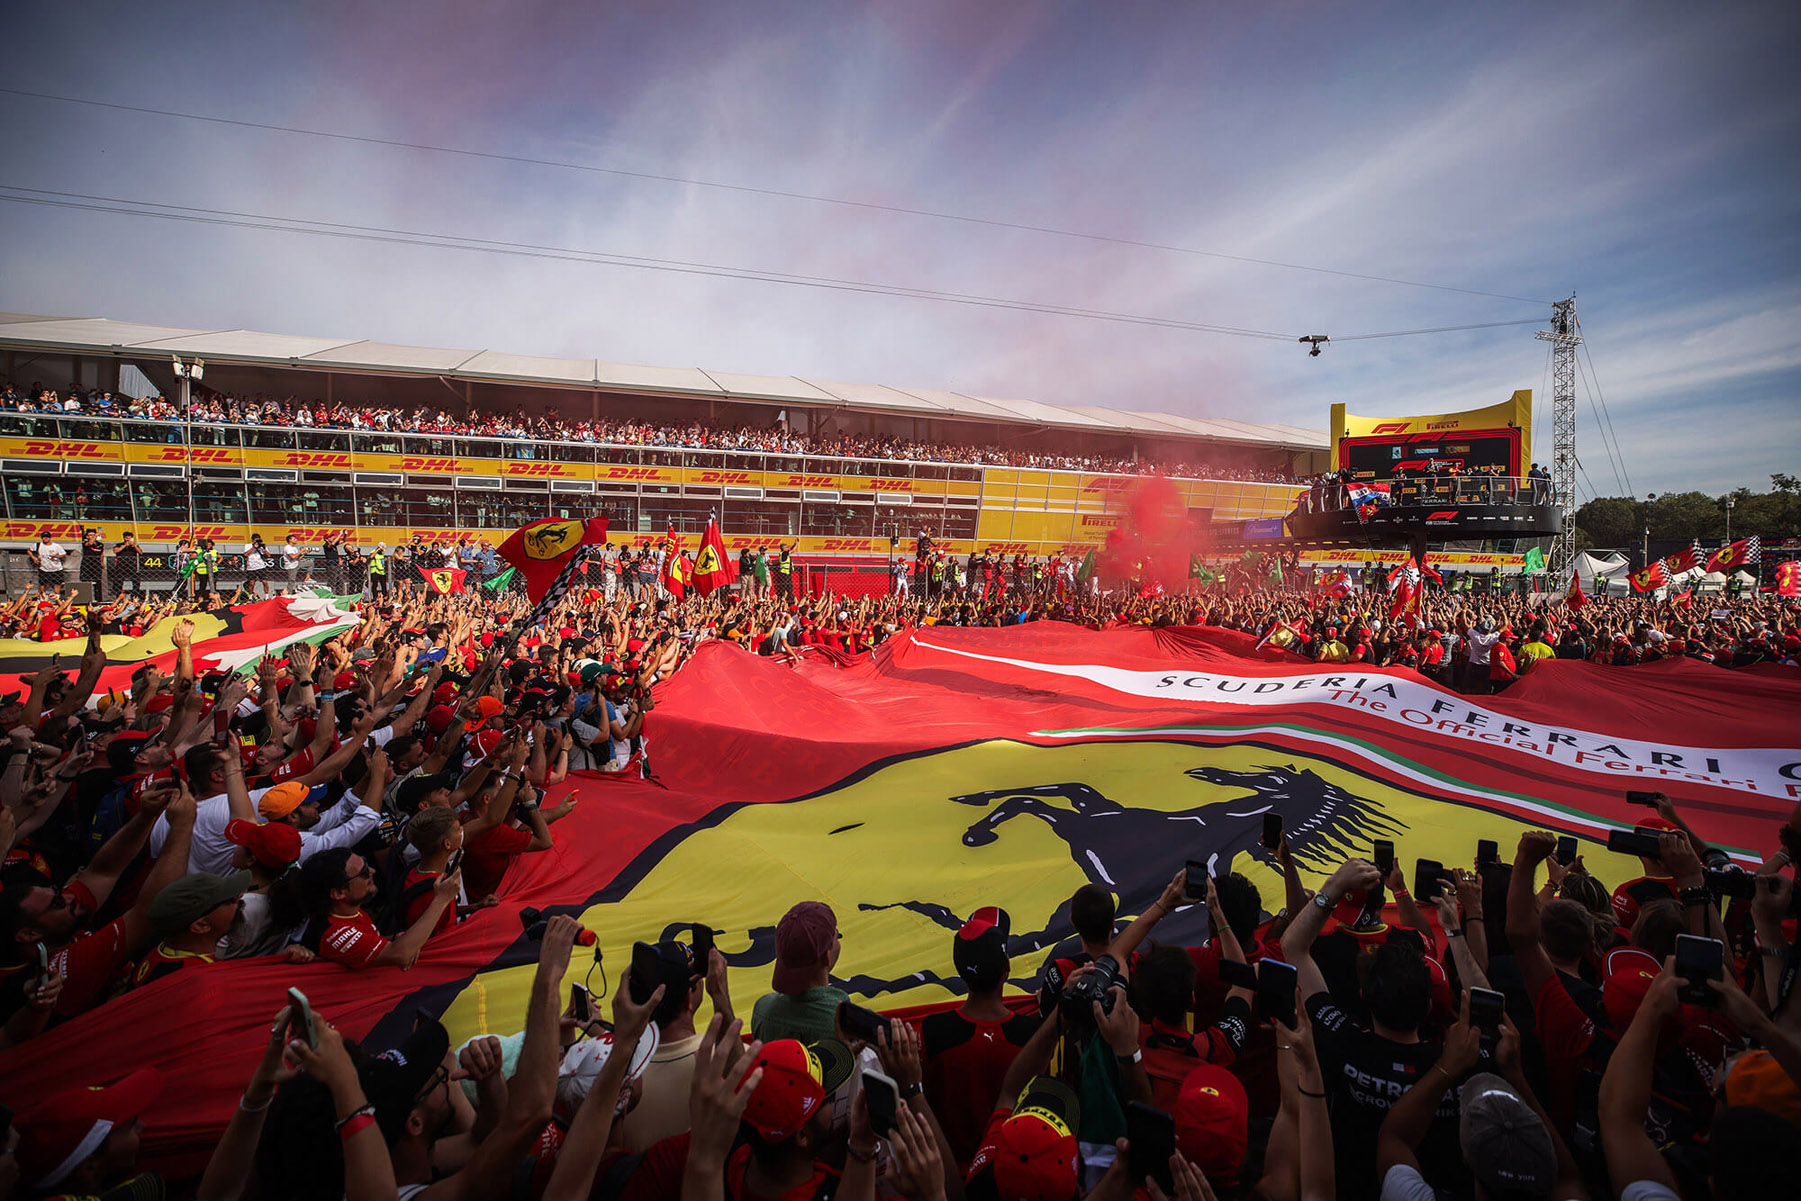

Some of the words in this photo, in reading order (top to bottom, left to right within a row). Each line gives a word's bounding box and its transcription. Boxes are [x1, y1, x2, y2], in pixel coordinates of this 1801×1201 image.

[1371, 422, 1412, 434] F1
[20, 441, 104, 457] DHL
[161, 447, 235, 462] DHL
[285, 453, 352, 467] DHL
[402, 458, 463, 471] DHL
[508, 463, 566, 476] DHL
[607, 467, 661, 480] DHL
[701, 472, 751, 483] DHL
[788, 476, 835, 487] DHL
[870, 479, 912, 491] DHL
[1425, 511, 1460, 520] F1
[4, 523, 83, 540] DHL
[153, 526, 225, 541] DHL
[288, 529, 358, 542] DHL
[412, 531, 477, 543] DHL
[731, 537, 787, 549] DHL
[823, 539, 873, 551] DHL
[986, 543, 1030, 555] DHL
[1328, 552, 1358, 560] DHL
[1379, 553, 1406, 561] DHL
[1468, 555, 1492, 563] DHL
[144, 557, 162, 568] 44
[1156, 675, 1399, 699] SCUDERIA
[1431, 699, 1721, 774] FERRARI
[1327, 689, 1388, 712] The
[1400, 709, 1555, 755] Official
[1575, 751, 1757, 791] Ferrari
[331, 926, 358, 950] MAHLE
[1049, 966, 1062, 985] aws
